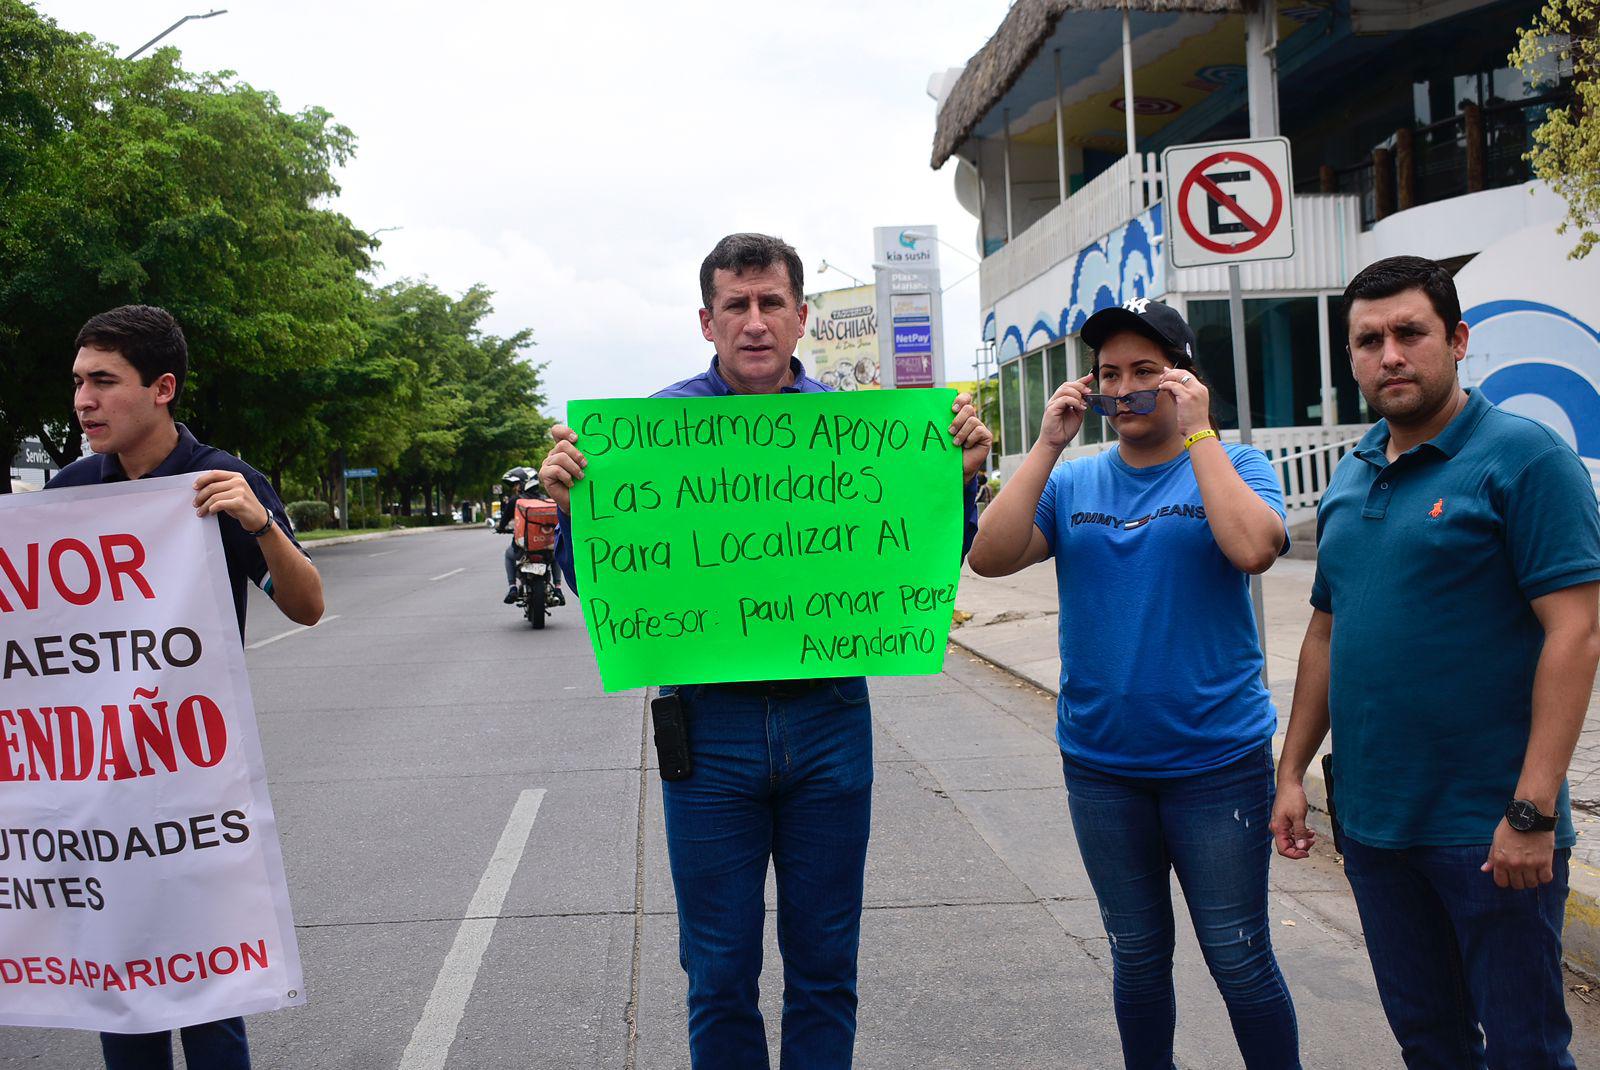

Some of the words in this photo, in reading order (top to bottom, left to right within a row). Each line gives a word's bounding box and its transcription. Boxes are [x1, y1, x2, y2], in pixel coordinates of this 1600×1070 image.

[887, 251, 903, 262] kia
[905, 250, 930, 261] sushi
[816, 317, 835, 341] LAS
[836, 314, 878, 340] CHILAK
[895, 333, 930, 344] NetPay
[581, 408, 796, 457] Solicitamos
[921, 420, 947, 452] A
[589, 480, 662, 521] Las
[675, 460, 883, 509] Autoridades
[1071, 511, 1124, 529] TOMMY
[1150, 503, 1206, 521] JEANS
[584, 536, 671, 583] Para
[692, 520, 860, 568] Localizar
[3, 626, 203, 680] AESTRO
[0, 687, 228, 783] ENDAÑO
[0, 939, 269, 991] DESAPARICION
